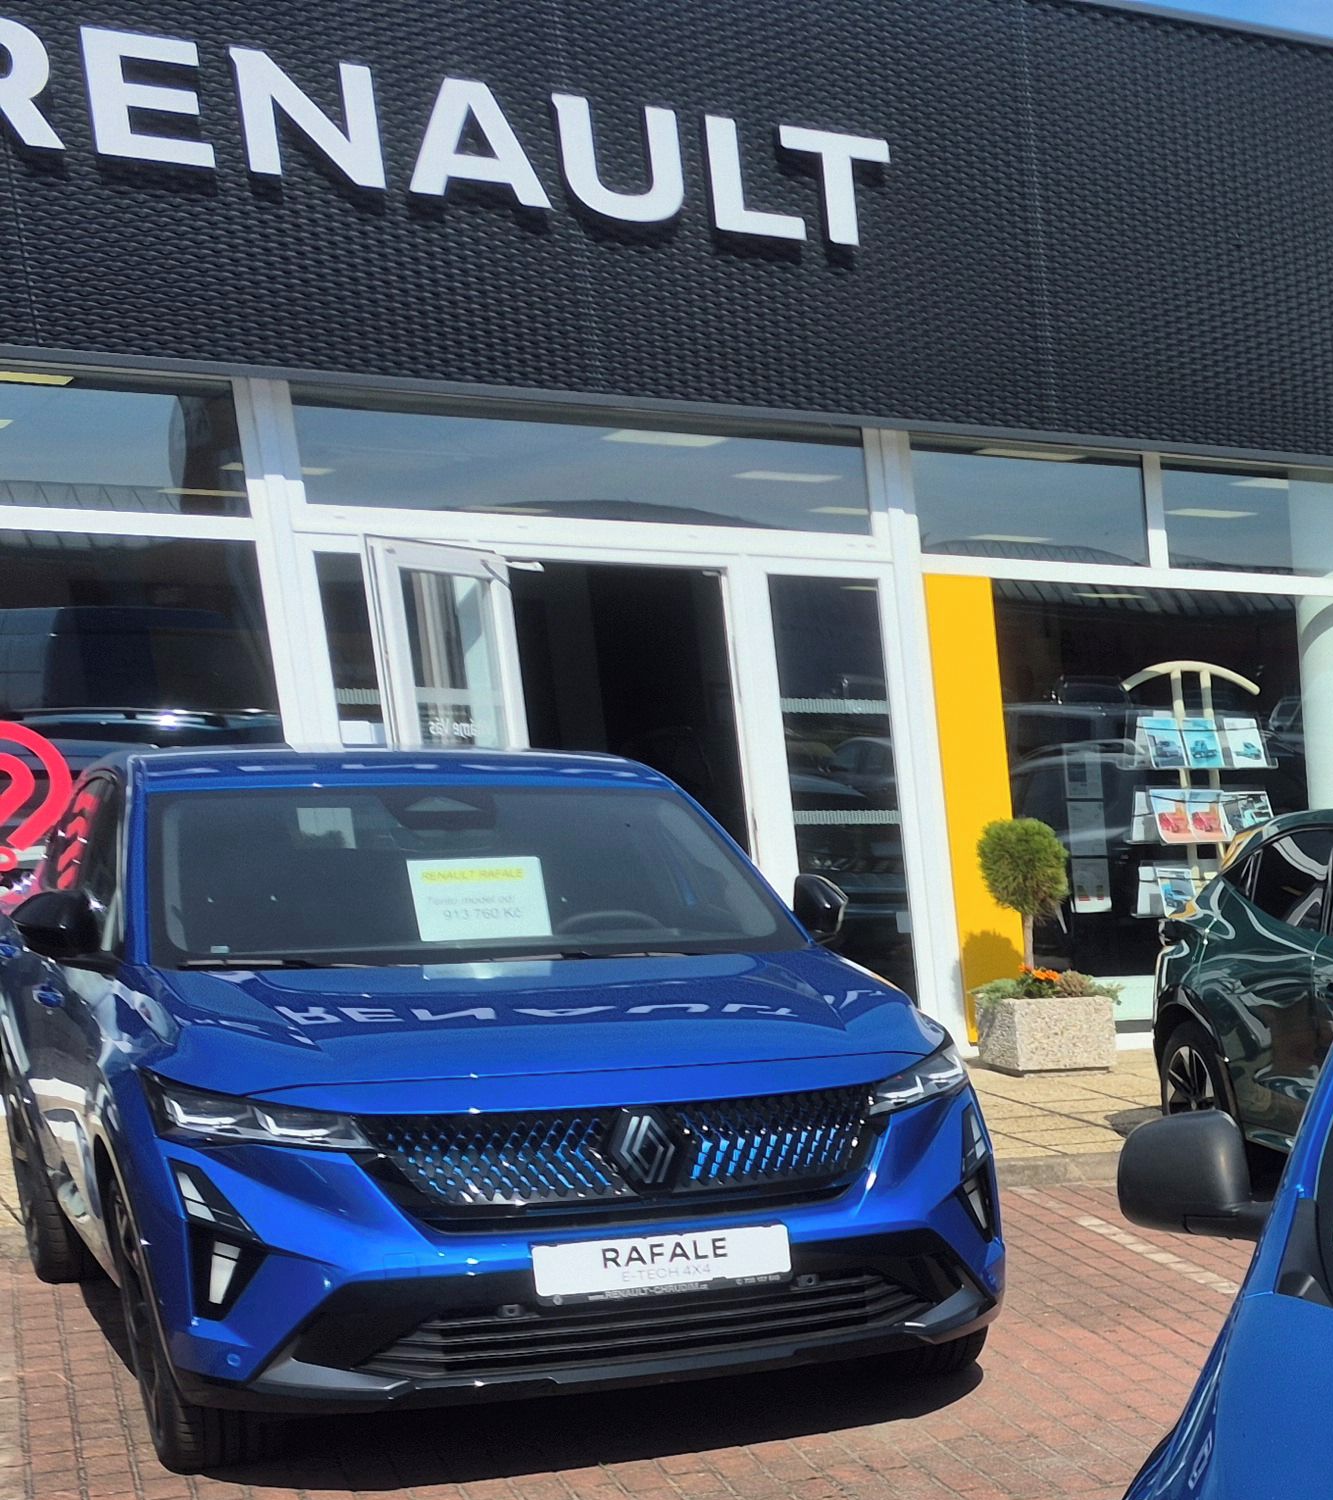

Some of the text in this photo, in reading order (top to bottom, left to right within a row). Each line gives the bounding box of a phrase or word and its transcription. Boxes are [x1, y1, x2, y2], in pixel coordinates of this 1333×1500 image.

[422, 868, 523, 881] RENAULT RAFALE
[601, 1237, 729, 1269] RAFALE
[621, 1266, 680, 1283] E-TECH
